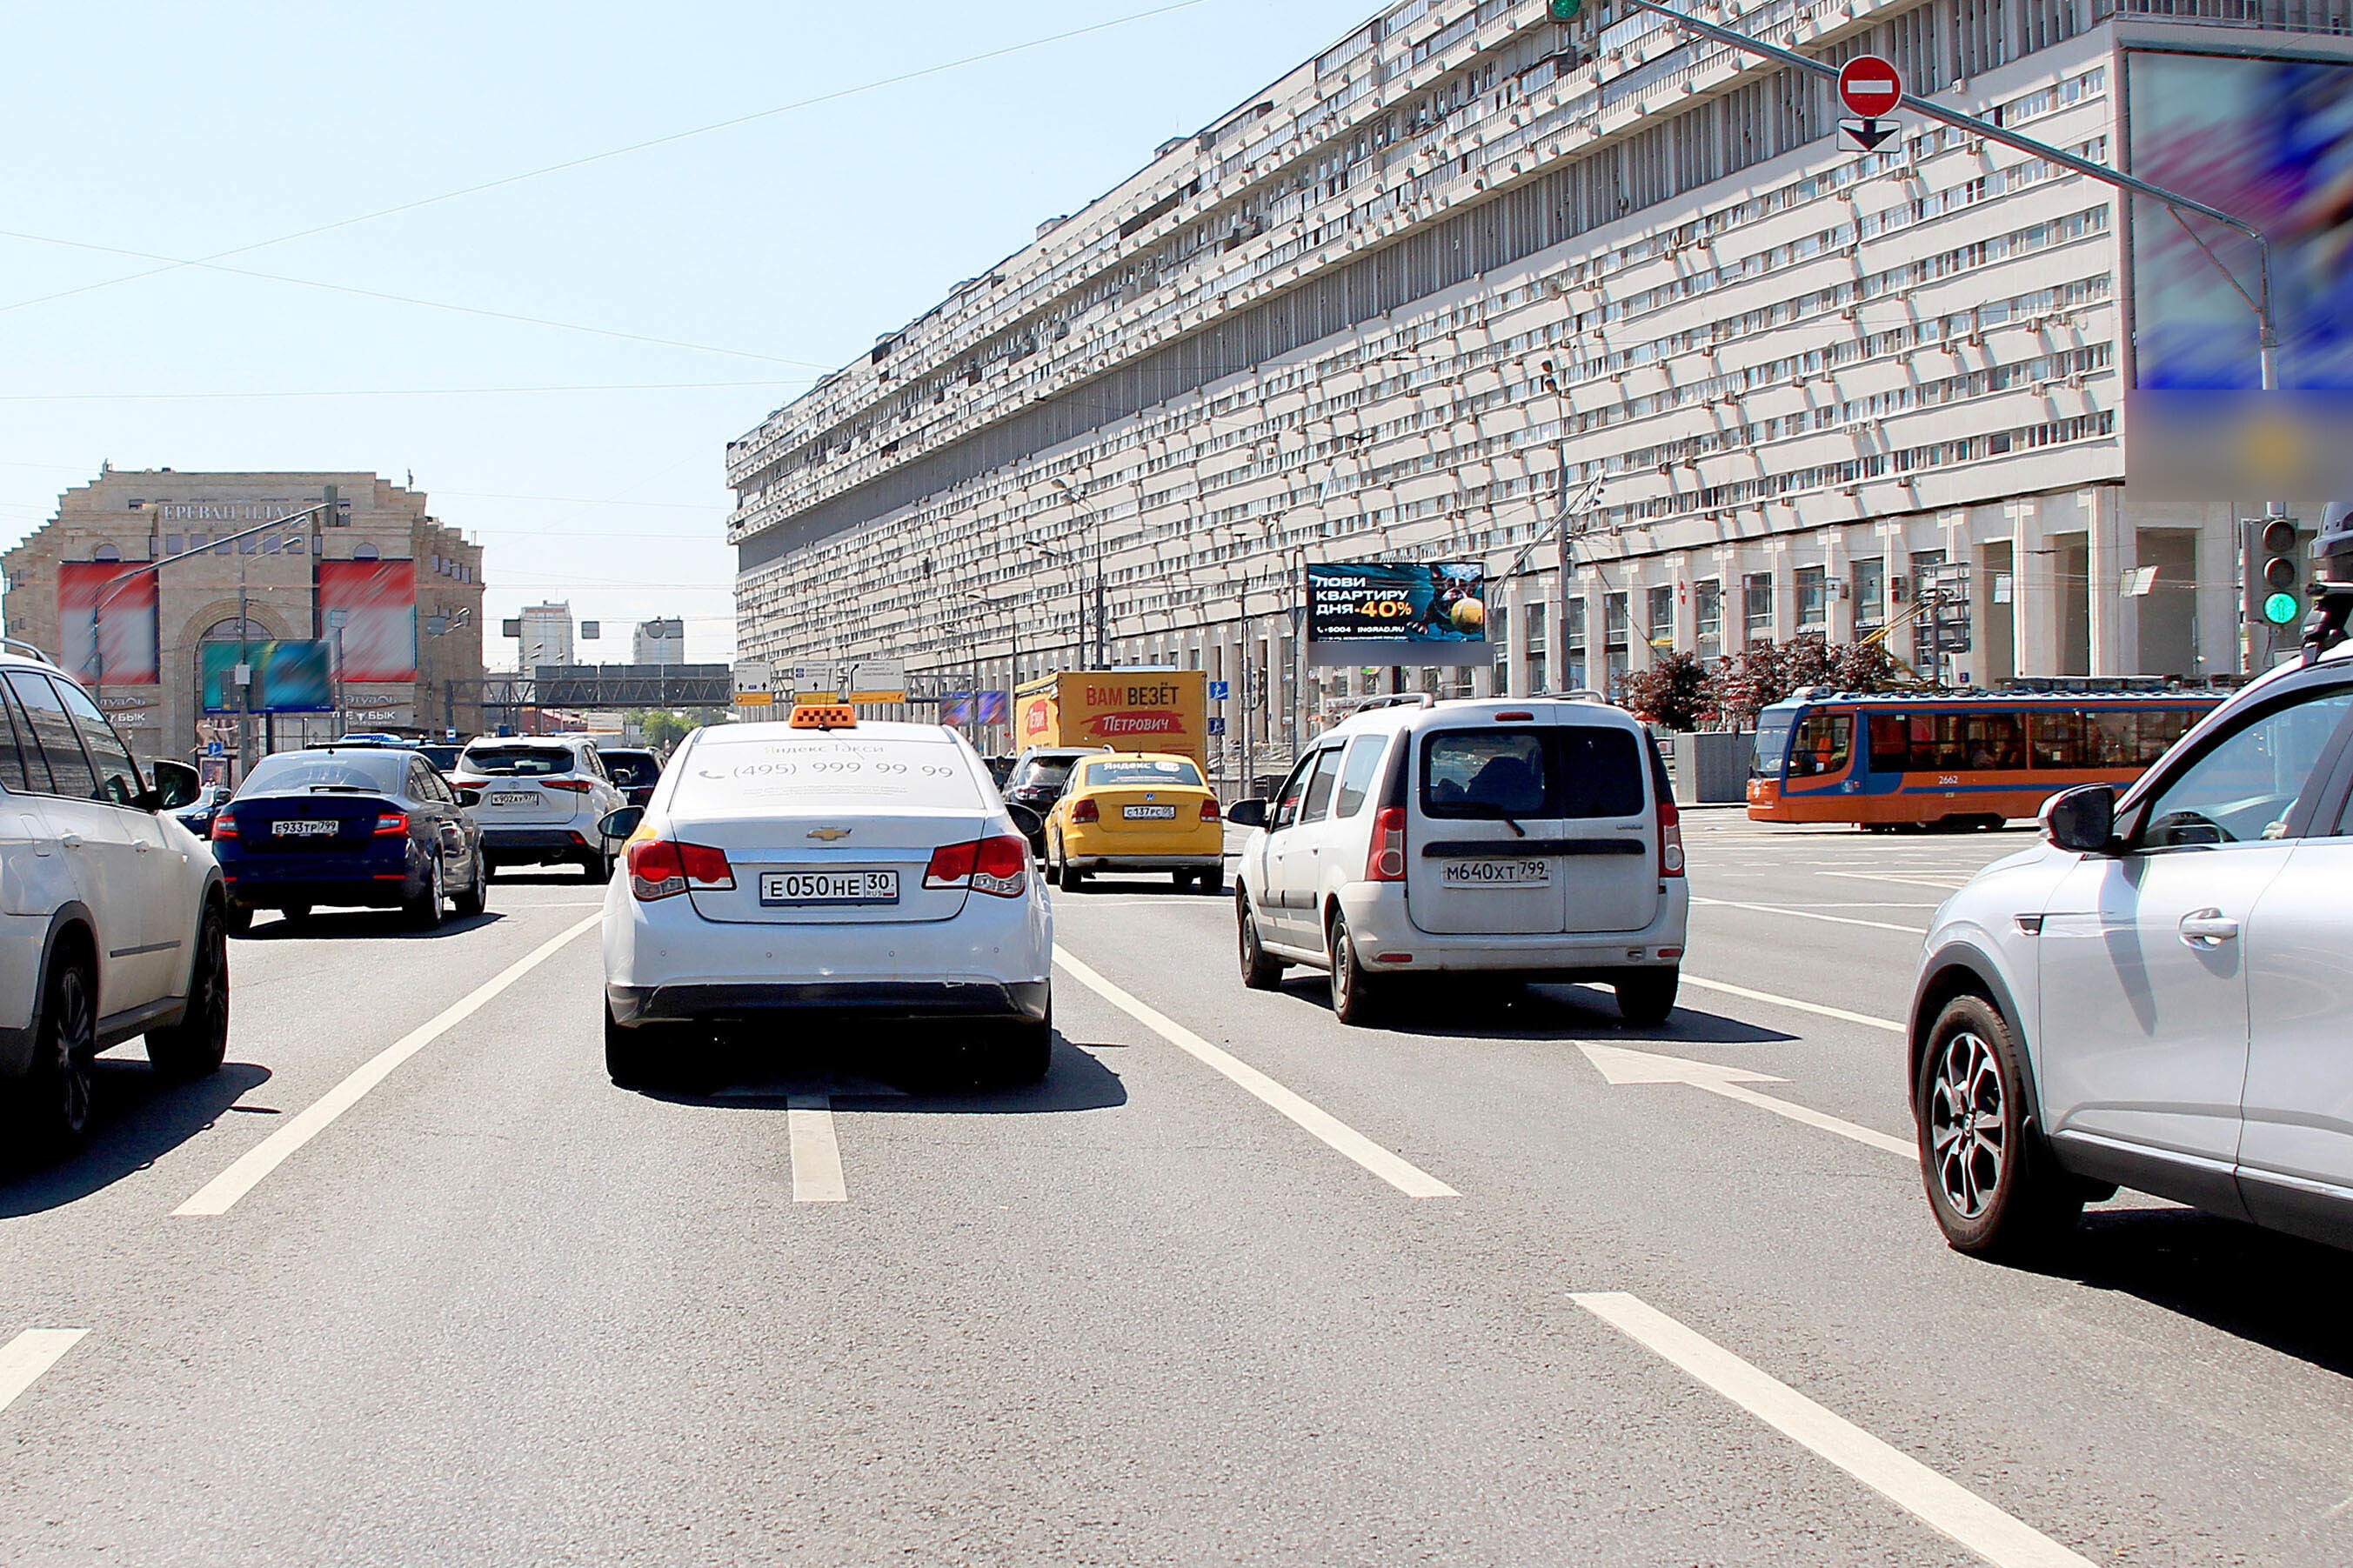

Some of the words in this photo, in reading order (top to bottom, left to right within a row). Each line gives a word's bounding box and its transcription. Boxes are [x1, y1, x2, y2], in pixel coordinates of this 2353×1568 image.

[164, 505, 235, 520] ЕРЕВАН
[1316, 577, 1367, 588] ЛОВИ
[1315, 590, 1409, 601] КВАРТИРУ
[1315, 603, 1354, 616] ДНЯ
[1354, 600, 1413, 617] -40%
[1086, 687, 1123, 706] ВАМ
[1127, 683, 1180, 705] ВЕЗЁТ
[117, 712, 146, 722] БЫК
[368, 711, 396, 720] БЫК
[765, 744, 827, 754] Яндекс
[733, 763, 797, 778] (495)
[812, 762, 861, 774] 999
[875, 762, 907, 774] 99
[922, 765, 953, 777] 99
[1103, 762, 1151, 771] Яндекс
[1938, 775, 1958, 784] 2662
[1520, 861, 1546, 875] 799
[771, 876, 860, 897] Е050НЕ
[866, 874, 889, 890] 30
